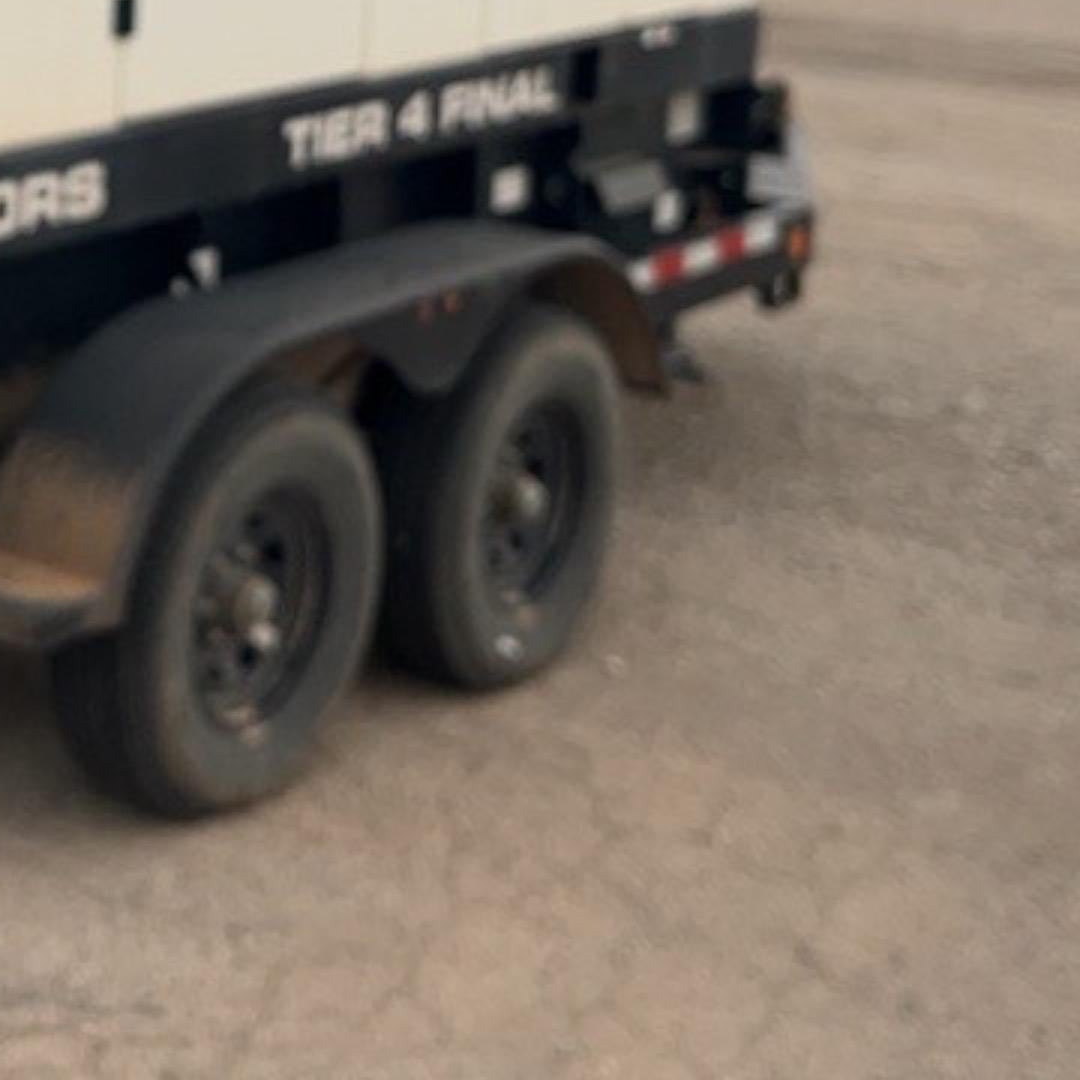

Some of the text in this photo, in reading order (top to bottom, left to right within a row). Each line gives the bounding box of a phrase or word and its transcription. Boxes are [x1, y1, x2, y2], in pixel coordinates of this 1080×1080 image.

[281, 65, 558, 169] TIER 4 FINAL
